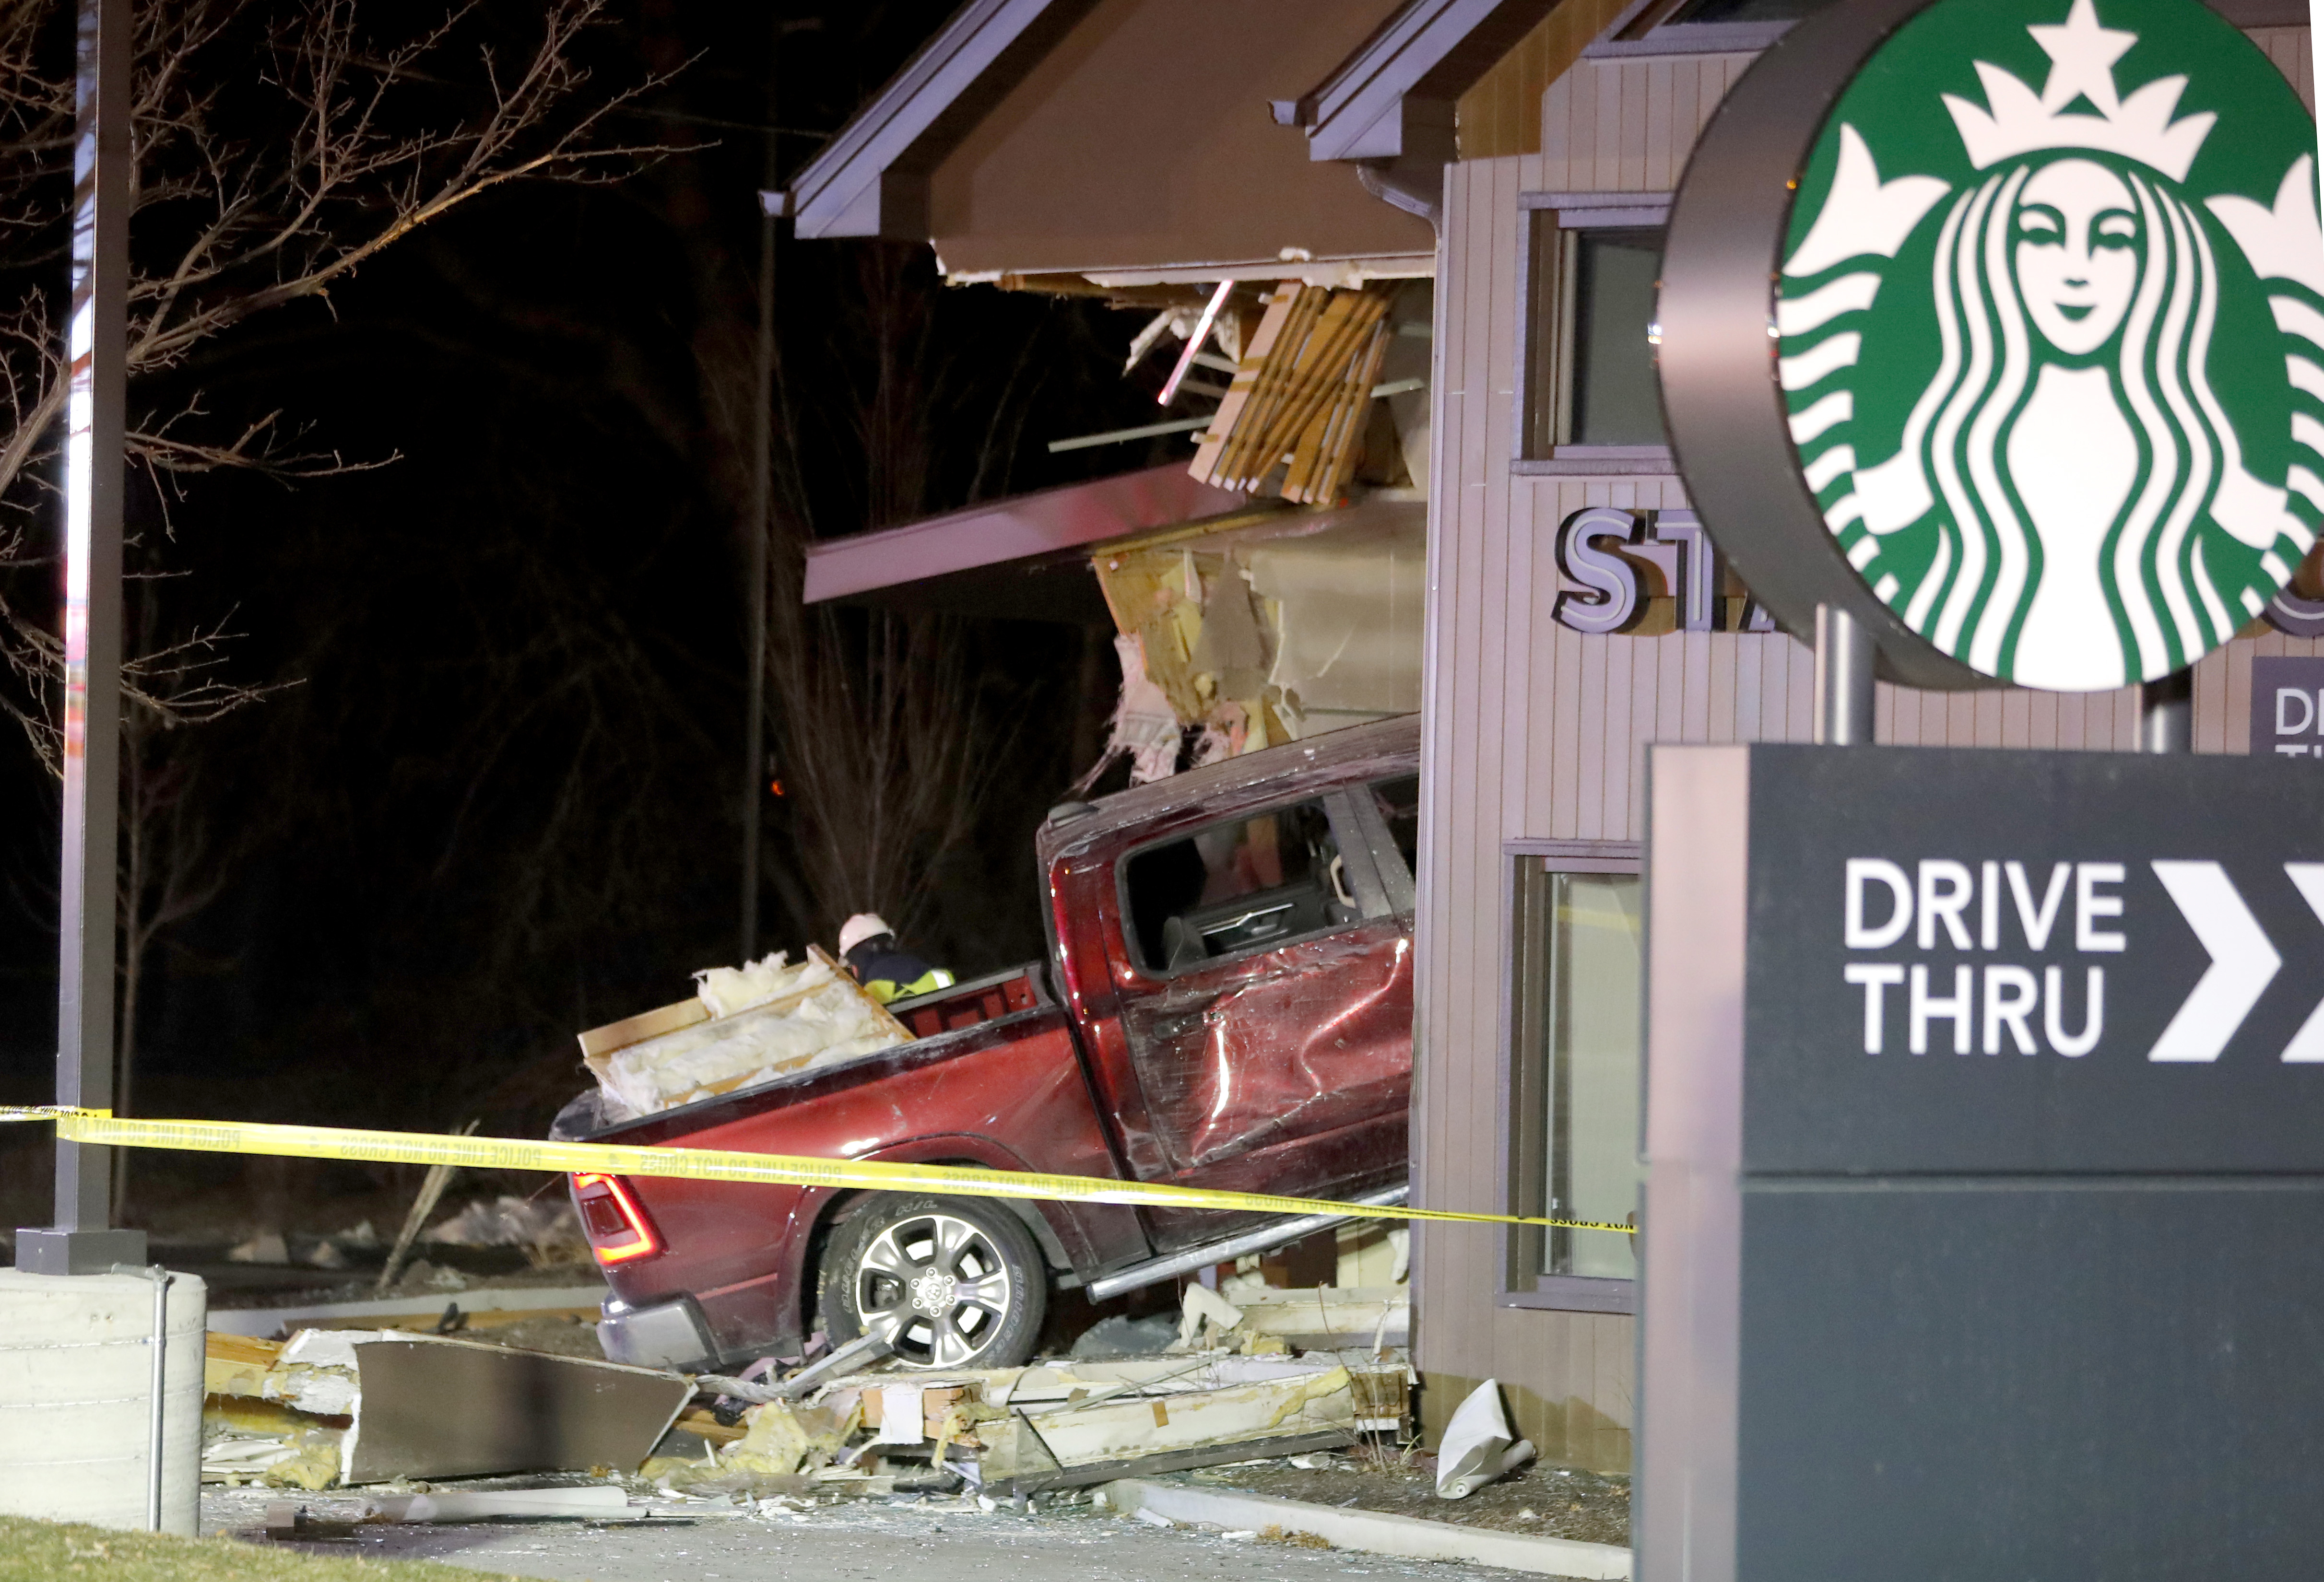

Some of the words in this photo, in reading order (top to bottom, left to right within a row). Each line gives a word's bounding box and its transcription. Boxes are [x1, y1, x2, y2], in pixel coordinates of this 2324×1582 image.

[1550, 507, 1775, 634] ST
[2275, 688, 2324, 736] D
[1844, 857, 2126, 951] DRIVE
[1844, 963, 2104, 1057] THRU
